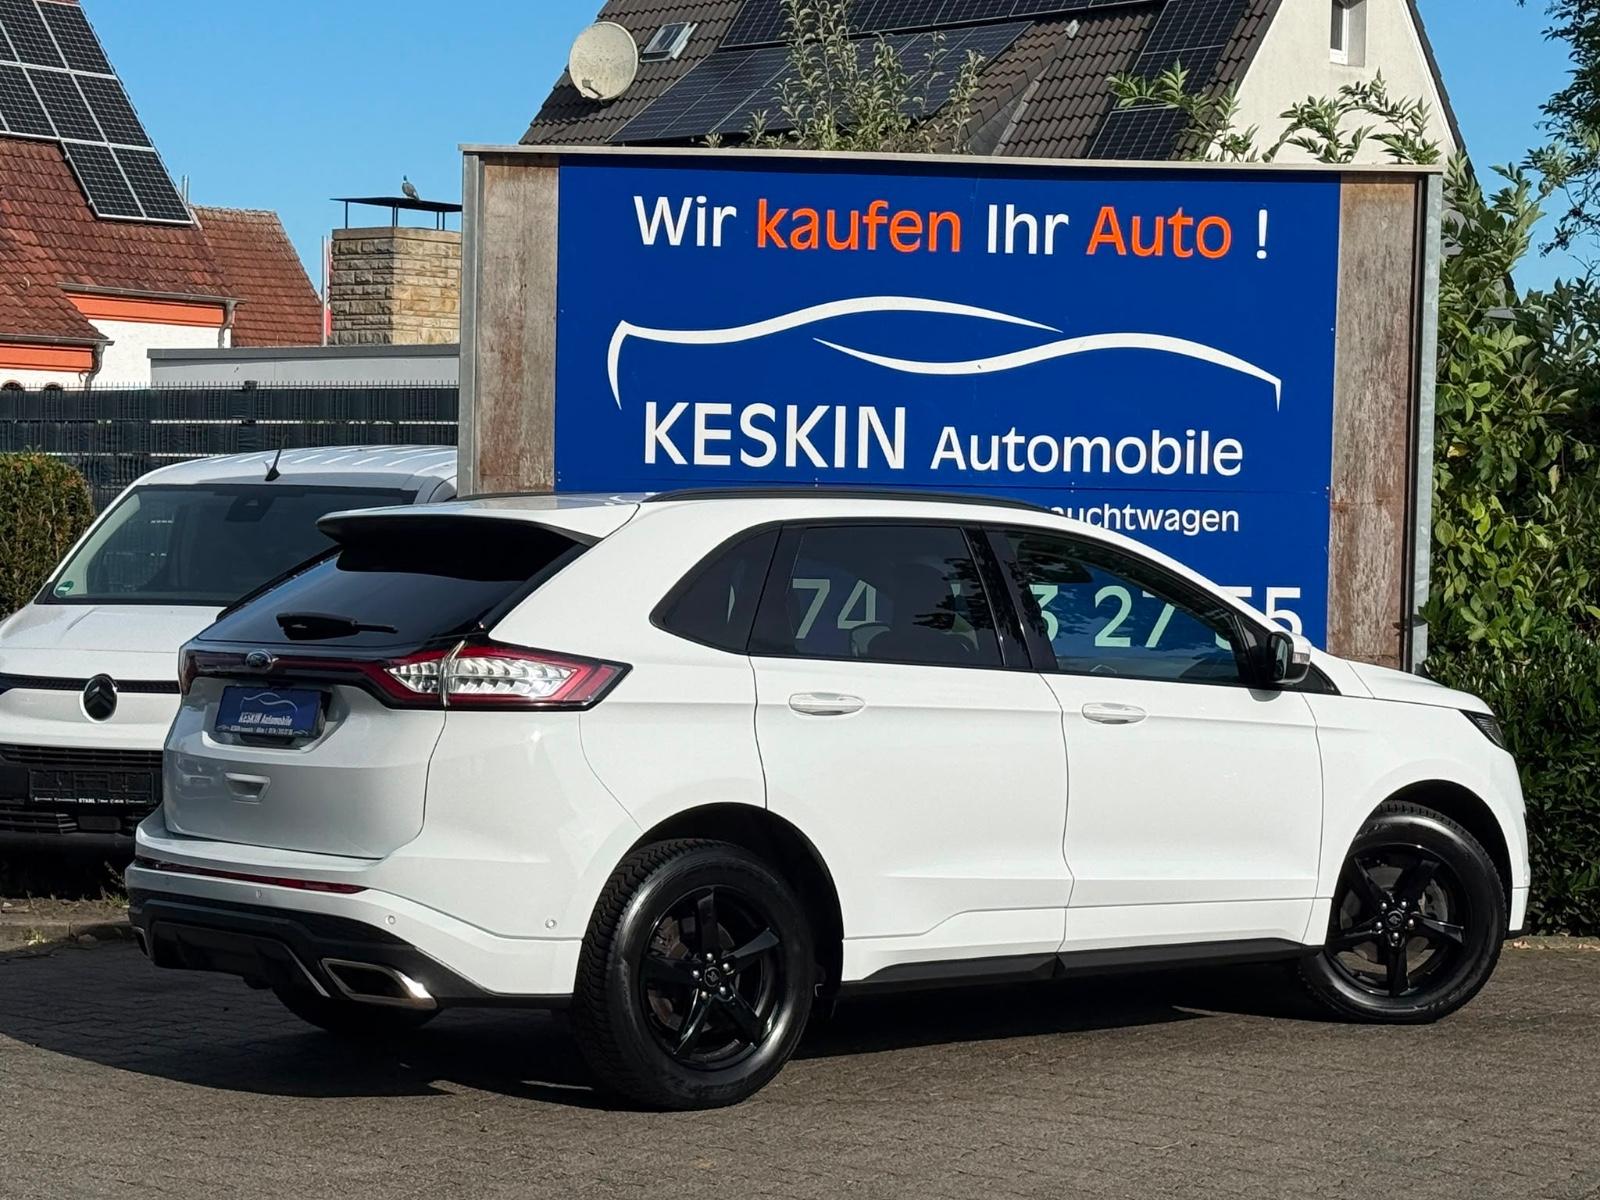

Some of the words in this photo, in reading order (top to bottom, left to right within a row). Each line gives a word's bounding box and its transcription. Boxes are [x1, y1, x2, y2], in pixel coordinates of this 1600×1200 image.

[634, 195, 737, 247] Wir
[757, 199, 961, 253] kaufen
[987, 204, 1069, 255] Ihr
[1087, 206, 1232, 259] Auto
[1256, 209, 1268, 260] !
[644, 402, 906, 470] KESKIN
[931, 427, 1243, 476] Automobile
